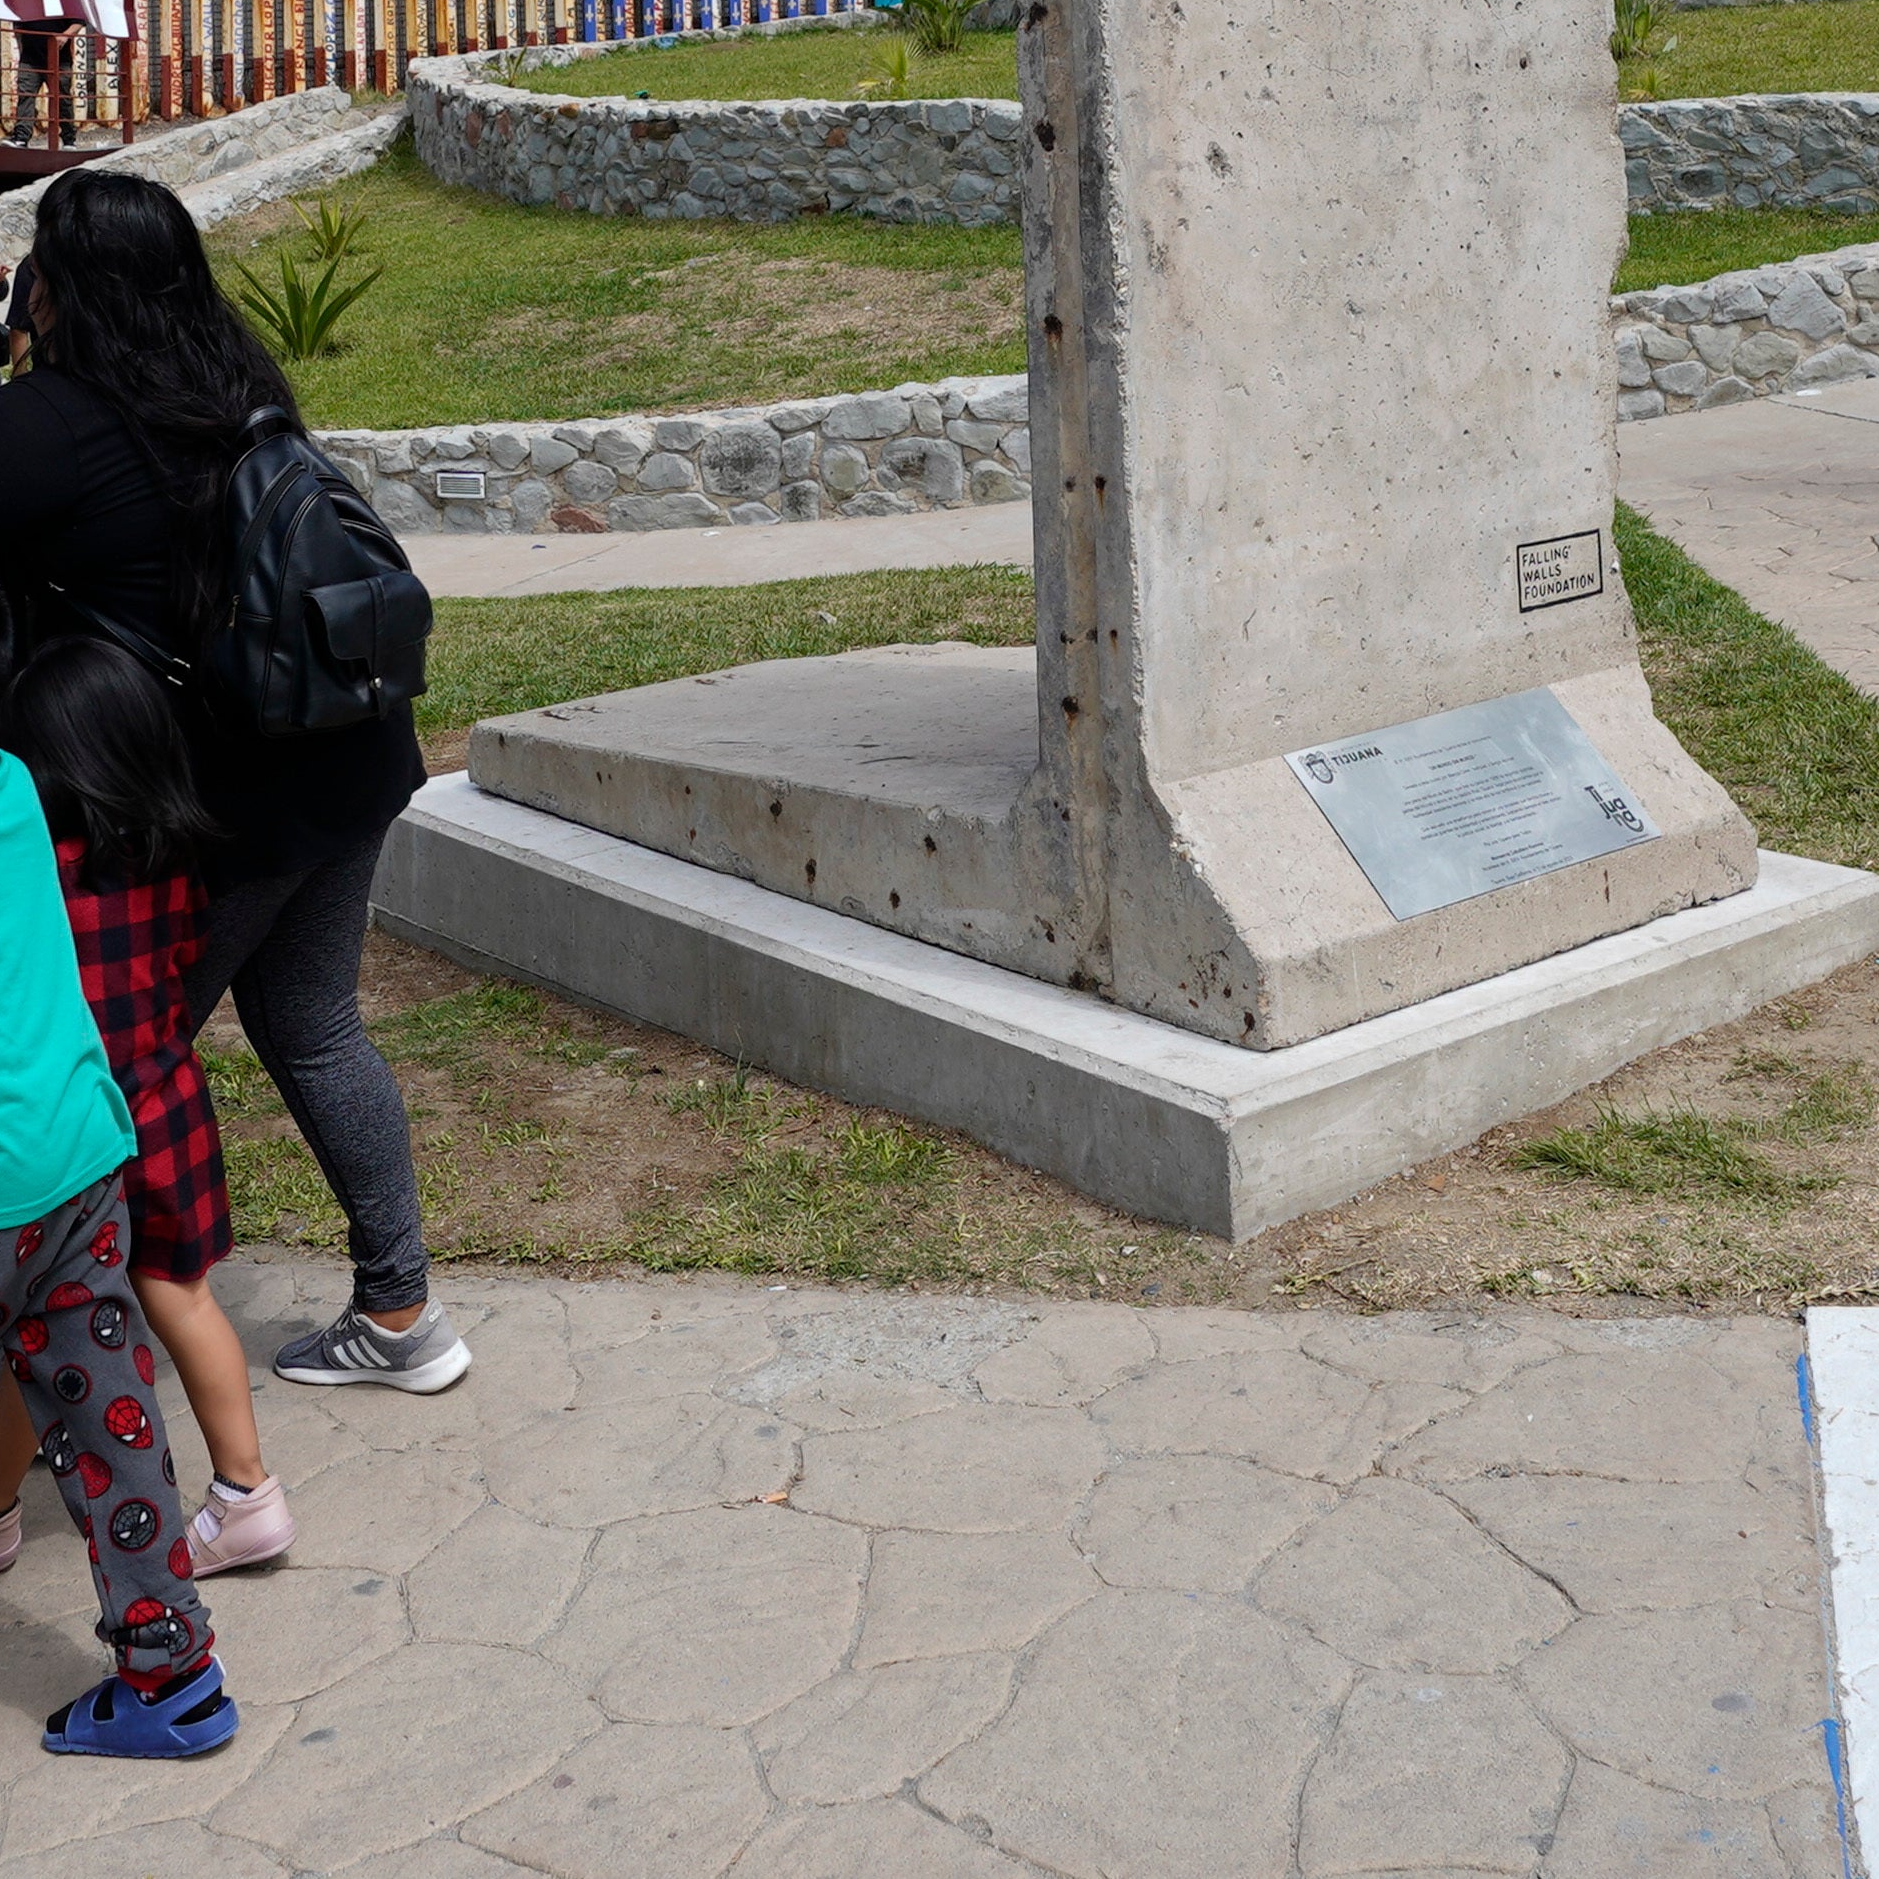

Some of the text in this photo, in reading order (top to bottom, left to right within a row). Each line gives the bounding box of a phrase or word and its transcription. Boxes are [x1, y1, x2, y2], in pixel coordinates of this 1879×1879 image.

[75, 37, 87, 108] LORENZO
[107, 43, 120, 90] ALEX
[263, 32, 274, 91] HECTOR
[1523, 564, 1561, 582] WALLS
[1525, 573, 1594, 600] FOUNDATION
[1331, 747, 1383, 766] TIJUANA
